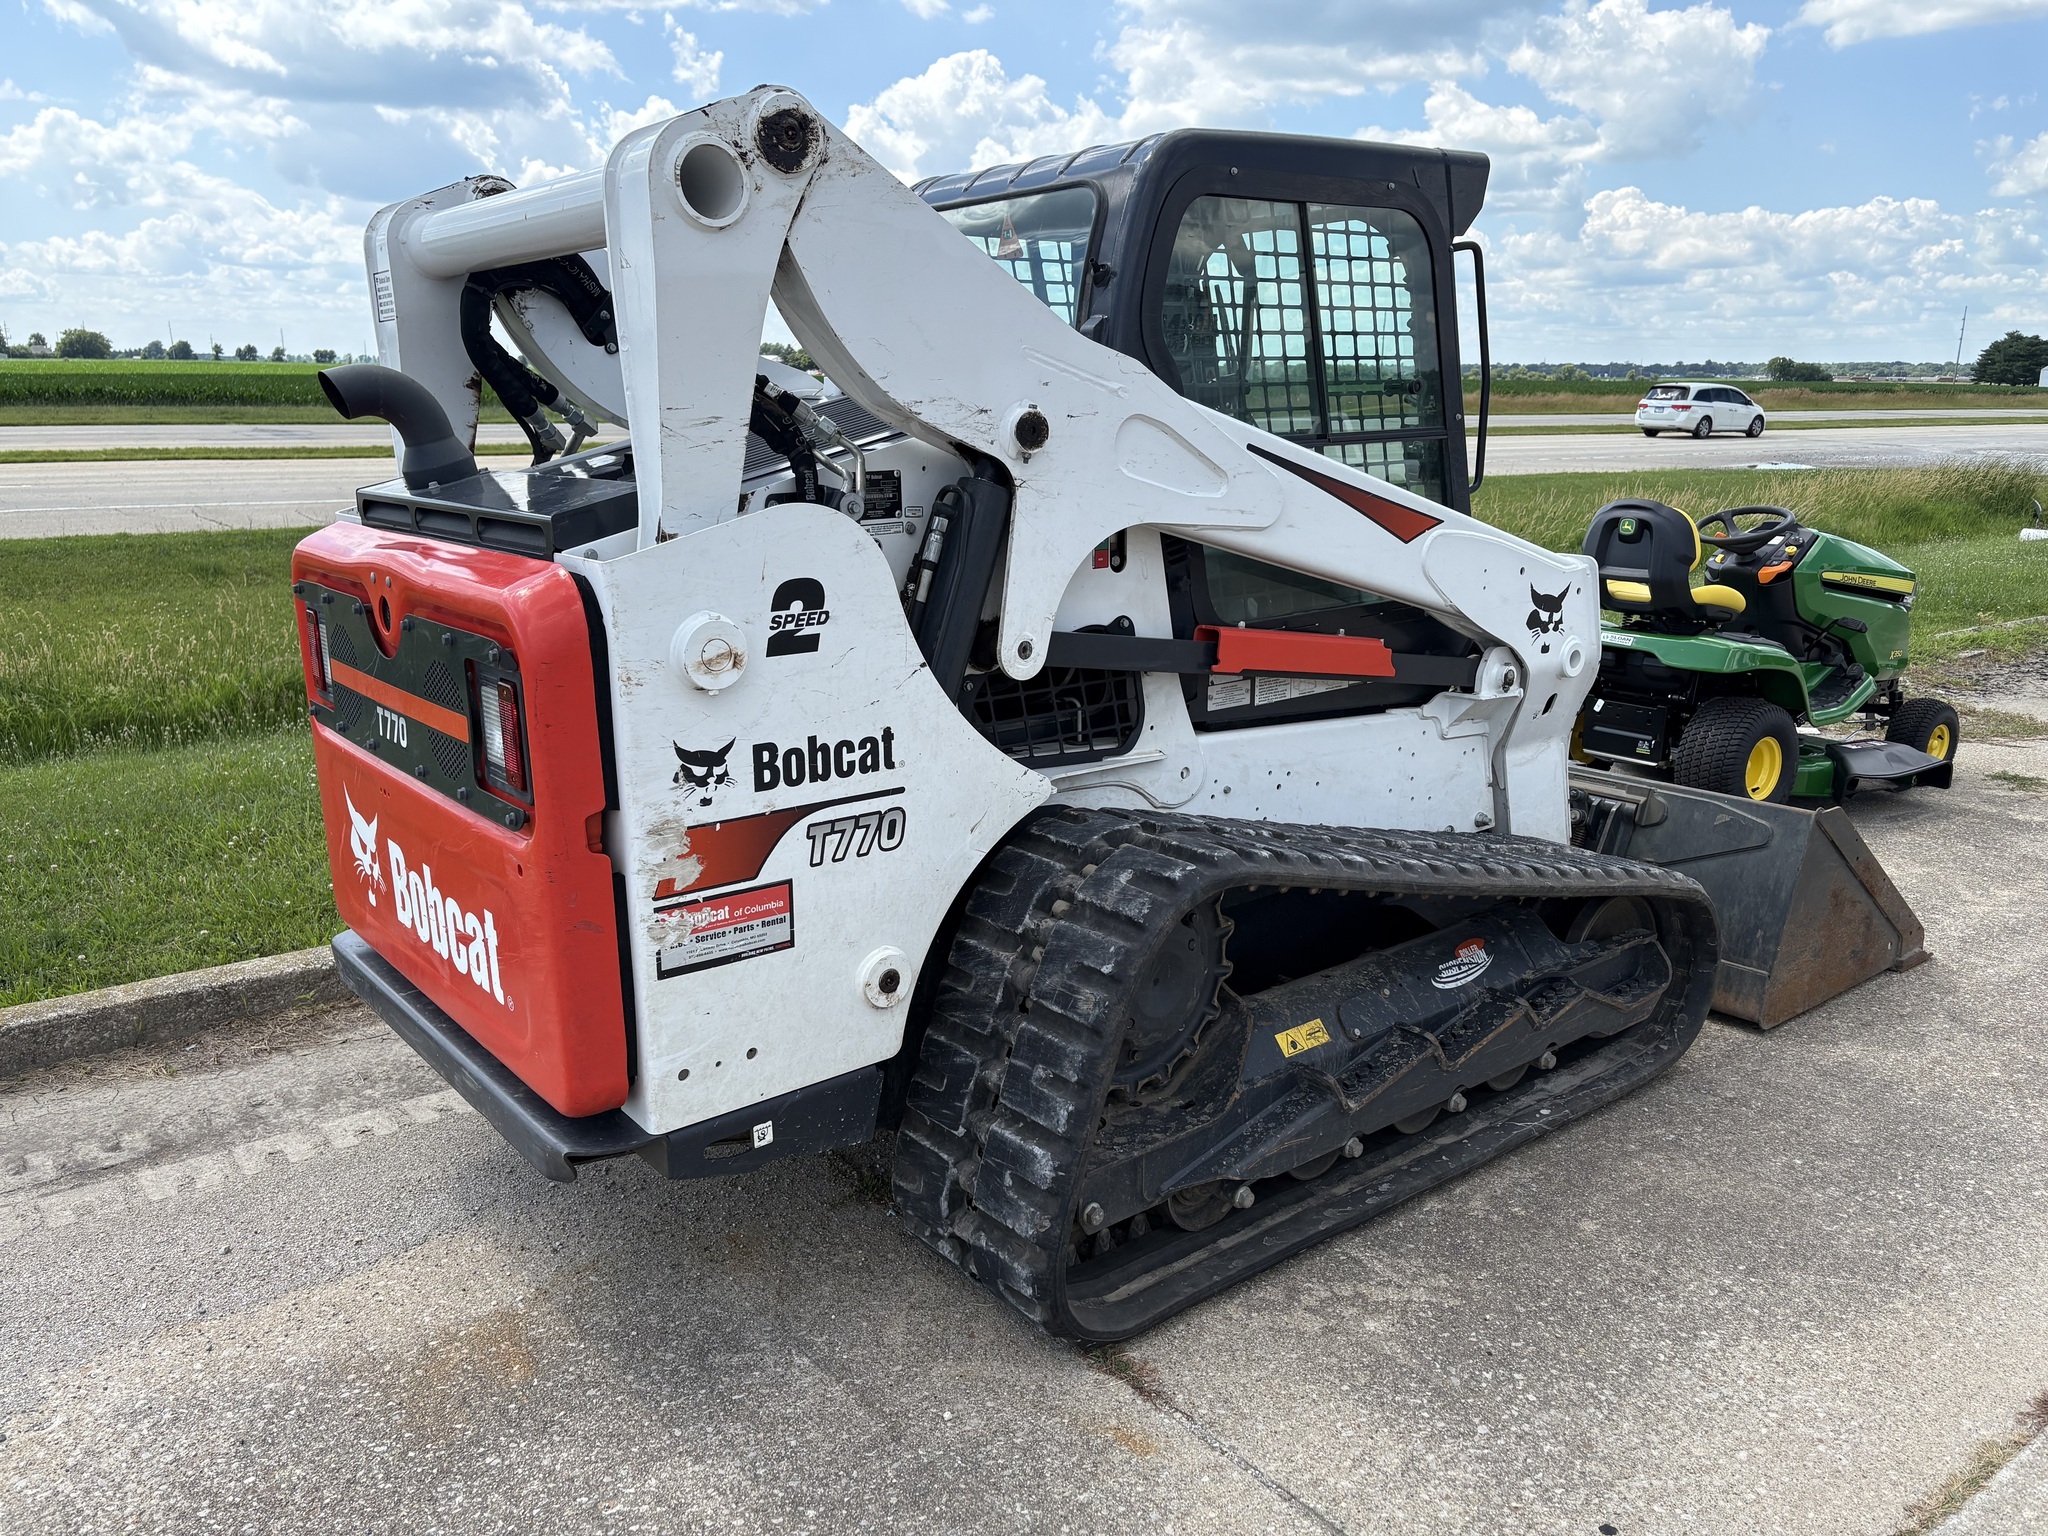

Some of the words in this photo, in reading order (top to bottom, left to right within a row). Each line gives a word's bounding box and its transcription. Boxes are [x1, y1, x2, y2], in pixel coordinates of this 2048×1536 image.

[804, 470, 817, 500] Bobcat
[1841, 573, 1857, 585] JOHN
[1858, 576, 1877, 587] DEERE
[766, 577, 825, 658] 2
[769, 610, 830, 630] SPEED
[376, 705, 408, 748] T770
[752, 726, 896, 793] Bobcat
[806, 806, 907, 868] T770
[386, 838, 505, 1006] Bobcat
[733, 908, 744, 917] of
[744, 899, 784, 914] Columbia
[695, 931, 727, 944] Service
[733, 924, 755, 935] Parts
[761, 915, 787, 929] Rental
[1458, 944, 1479, 958] ROLLER
